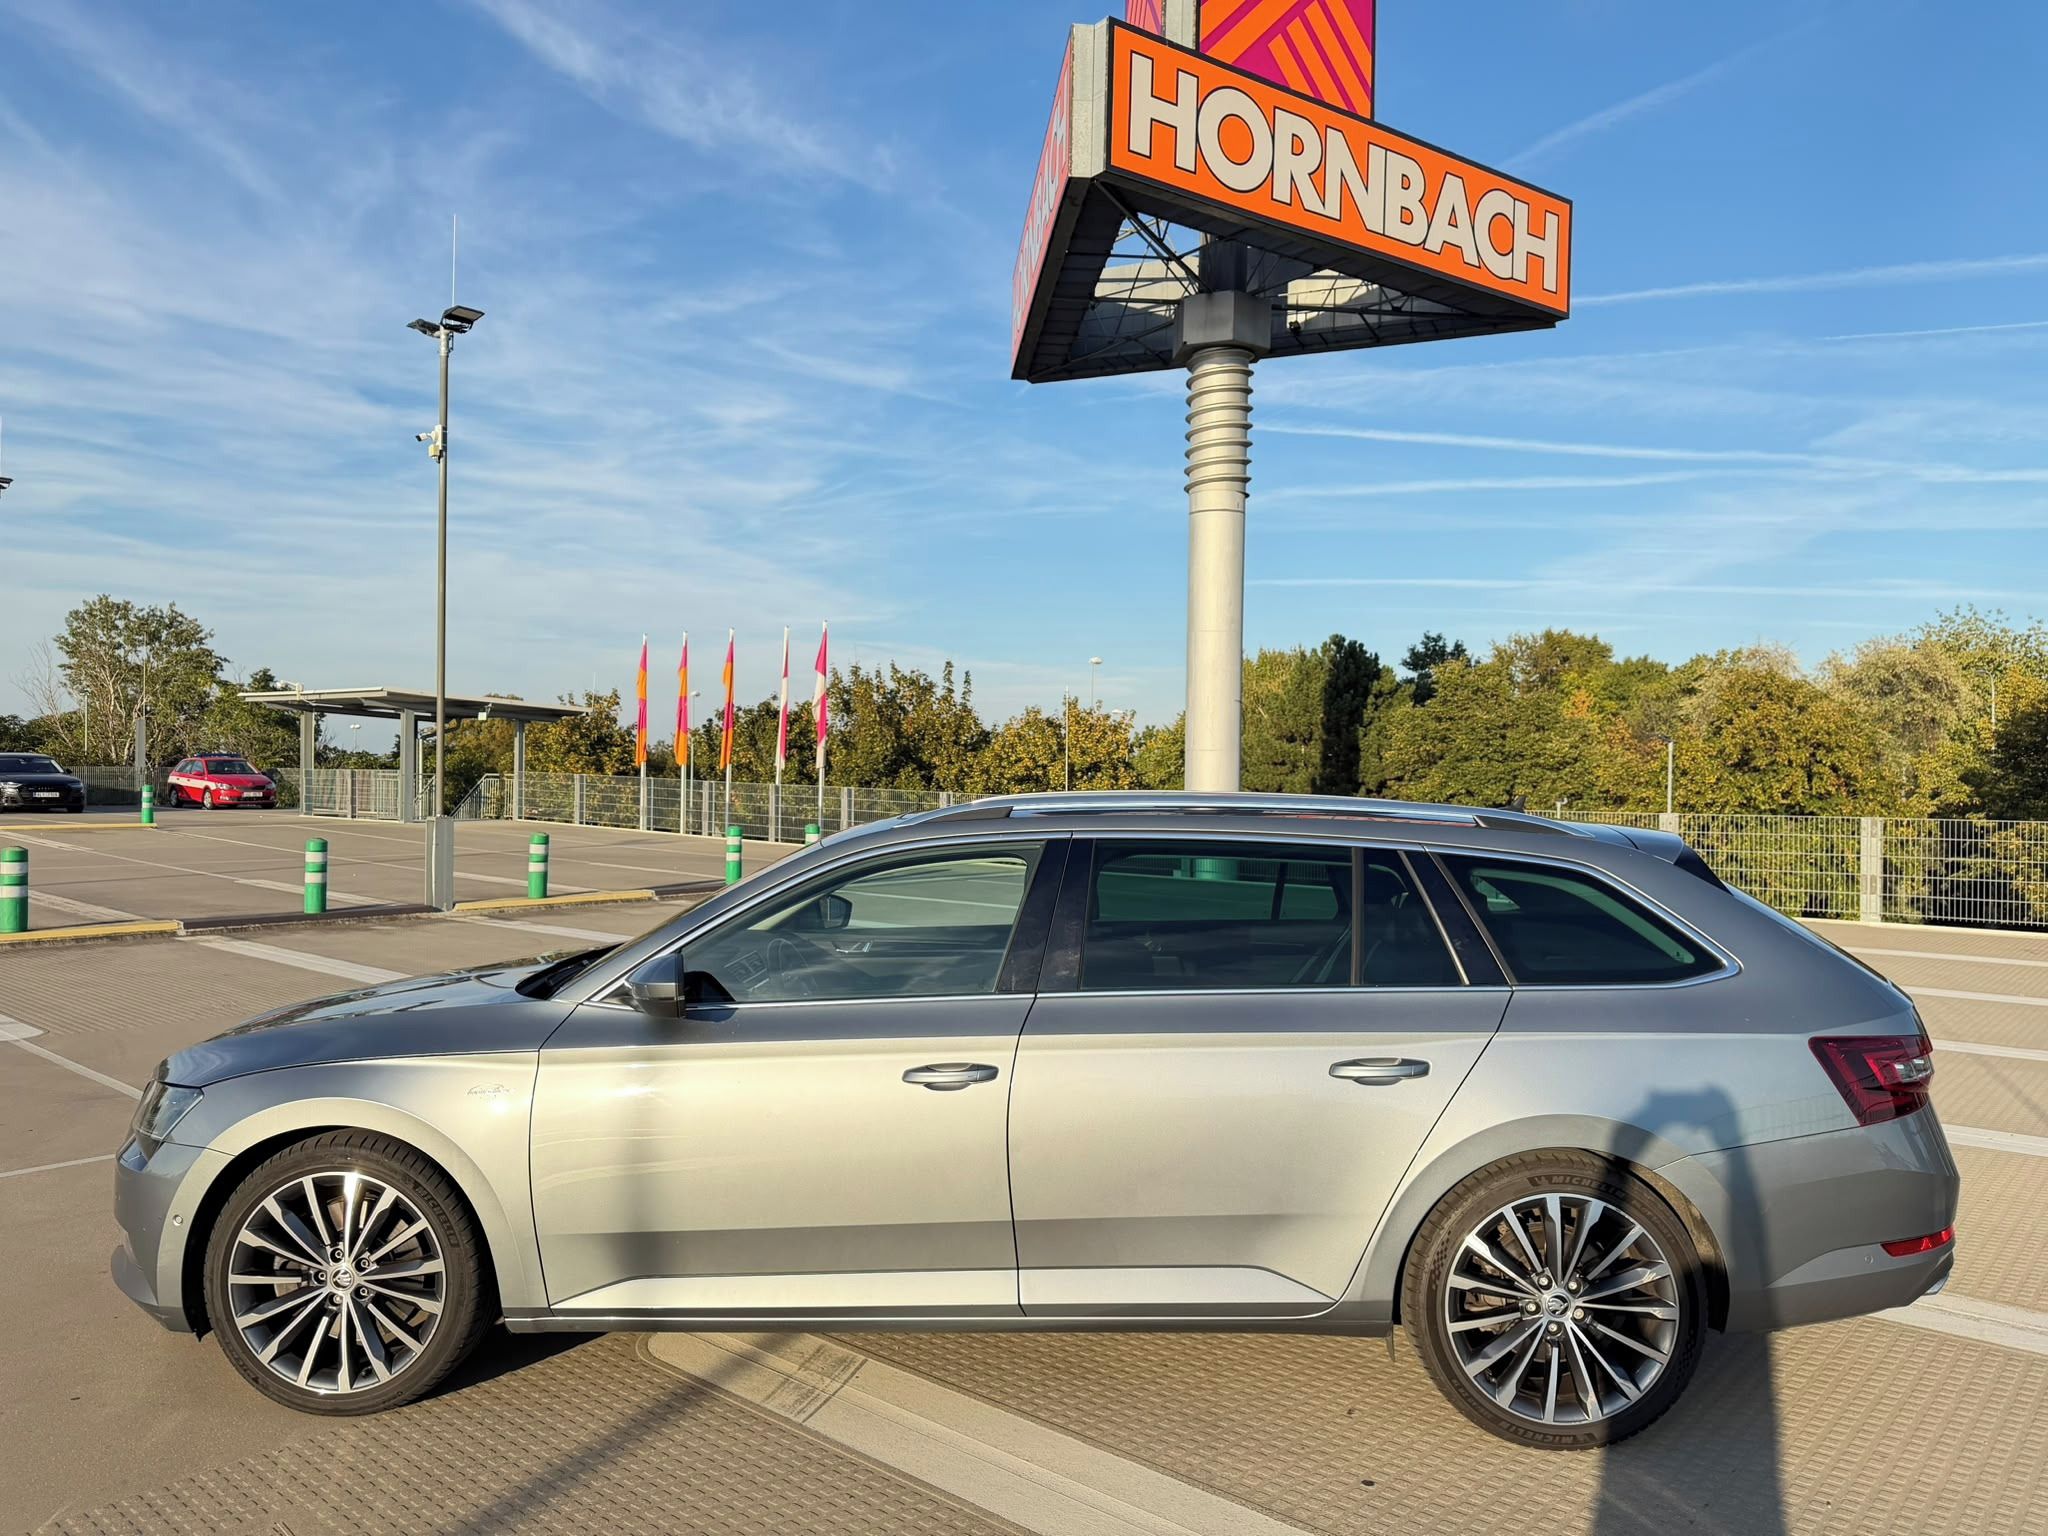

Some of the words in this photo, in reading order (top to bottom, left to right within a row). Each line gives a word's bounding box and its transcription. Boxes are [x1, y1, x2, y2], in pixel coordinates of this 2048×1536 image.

[1128, 51, 1559, 294] HORNBACH
[1551, 1175, 1627, 1199] MICHELIN
[415, 1187, 459, 1246] MICHELIN
[1499, 1420, 1573, 1445] MICHELIN
